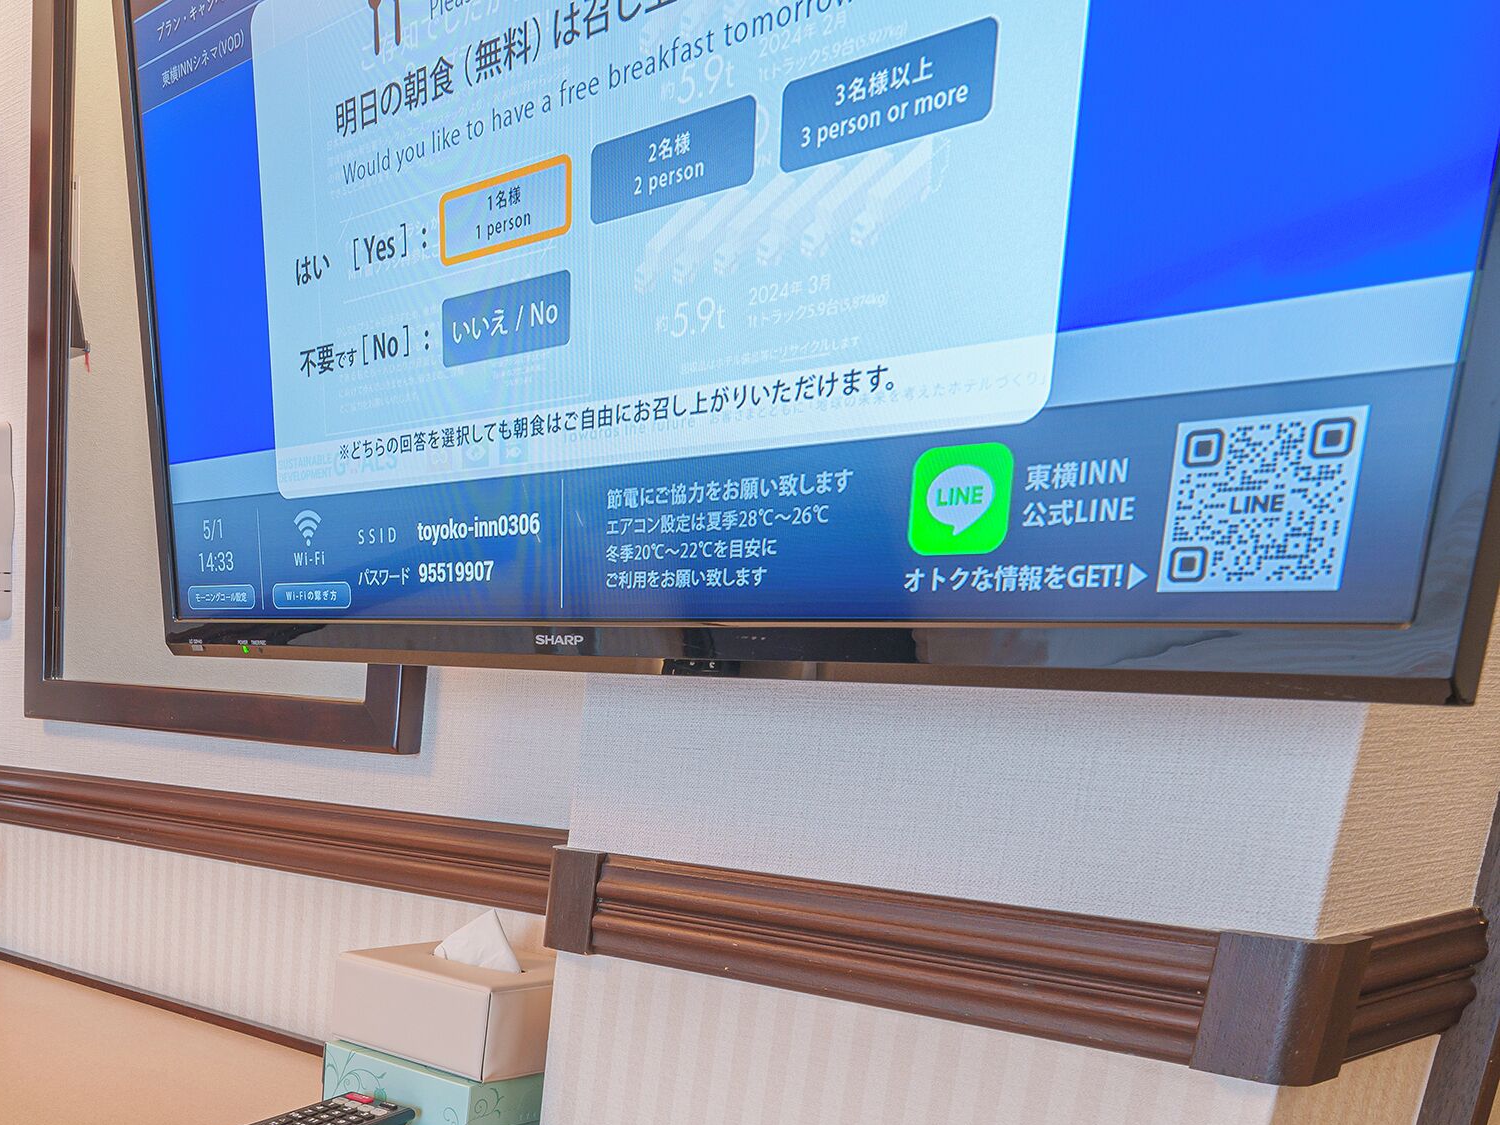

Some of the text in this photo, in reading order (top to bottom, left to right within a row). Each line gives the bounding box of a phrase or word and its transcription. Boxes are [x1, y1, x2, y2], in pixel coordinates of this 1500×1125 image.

[335, 0, 677, 138] 明日の朝食（無料）は召し
[835, 56, 935, 109] 3名様以上
[342, 0, 850, 185] Would you like to have a free breakfast tomorro
[800, 83, 970, 149] 3 person or more
[648, 130, 692, 164] 2名様
[633, 158, 705, 196] 2 person
[487, 185, 522, 211] 1名様
[476, 211, 532, 241] 1 person
[296, 250, 331, 286] はい
[452, 308, 509, 345] いいえ
[529, 300, 560, 328] No
[607, 468, 854, 511] 節電にご協力をお願い致します
[1024, 456, 1130, 492] 東横INN
[935, 485, 985, 508] LINE
[1021, 496, 1137, 528] 公式LINE
[1229, 493, 1286, 516] LINE
[202, 518, 224, 541] 5/1
[357, 512, 541, 546] SSID toyoko-inn0306
[198, 551, 235, 573] 14:33
[293, 551, 326, 568] Wi-Fi
[358, 560, 495, 587] パスワード 95519907
[605, 566, 768, 591] ご利用をお願い致します
[903, 562, 1124, 593] オトクな情報をGET!
[535, 633, 584, 647] SHARP
